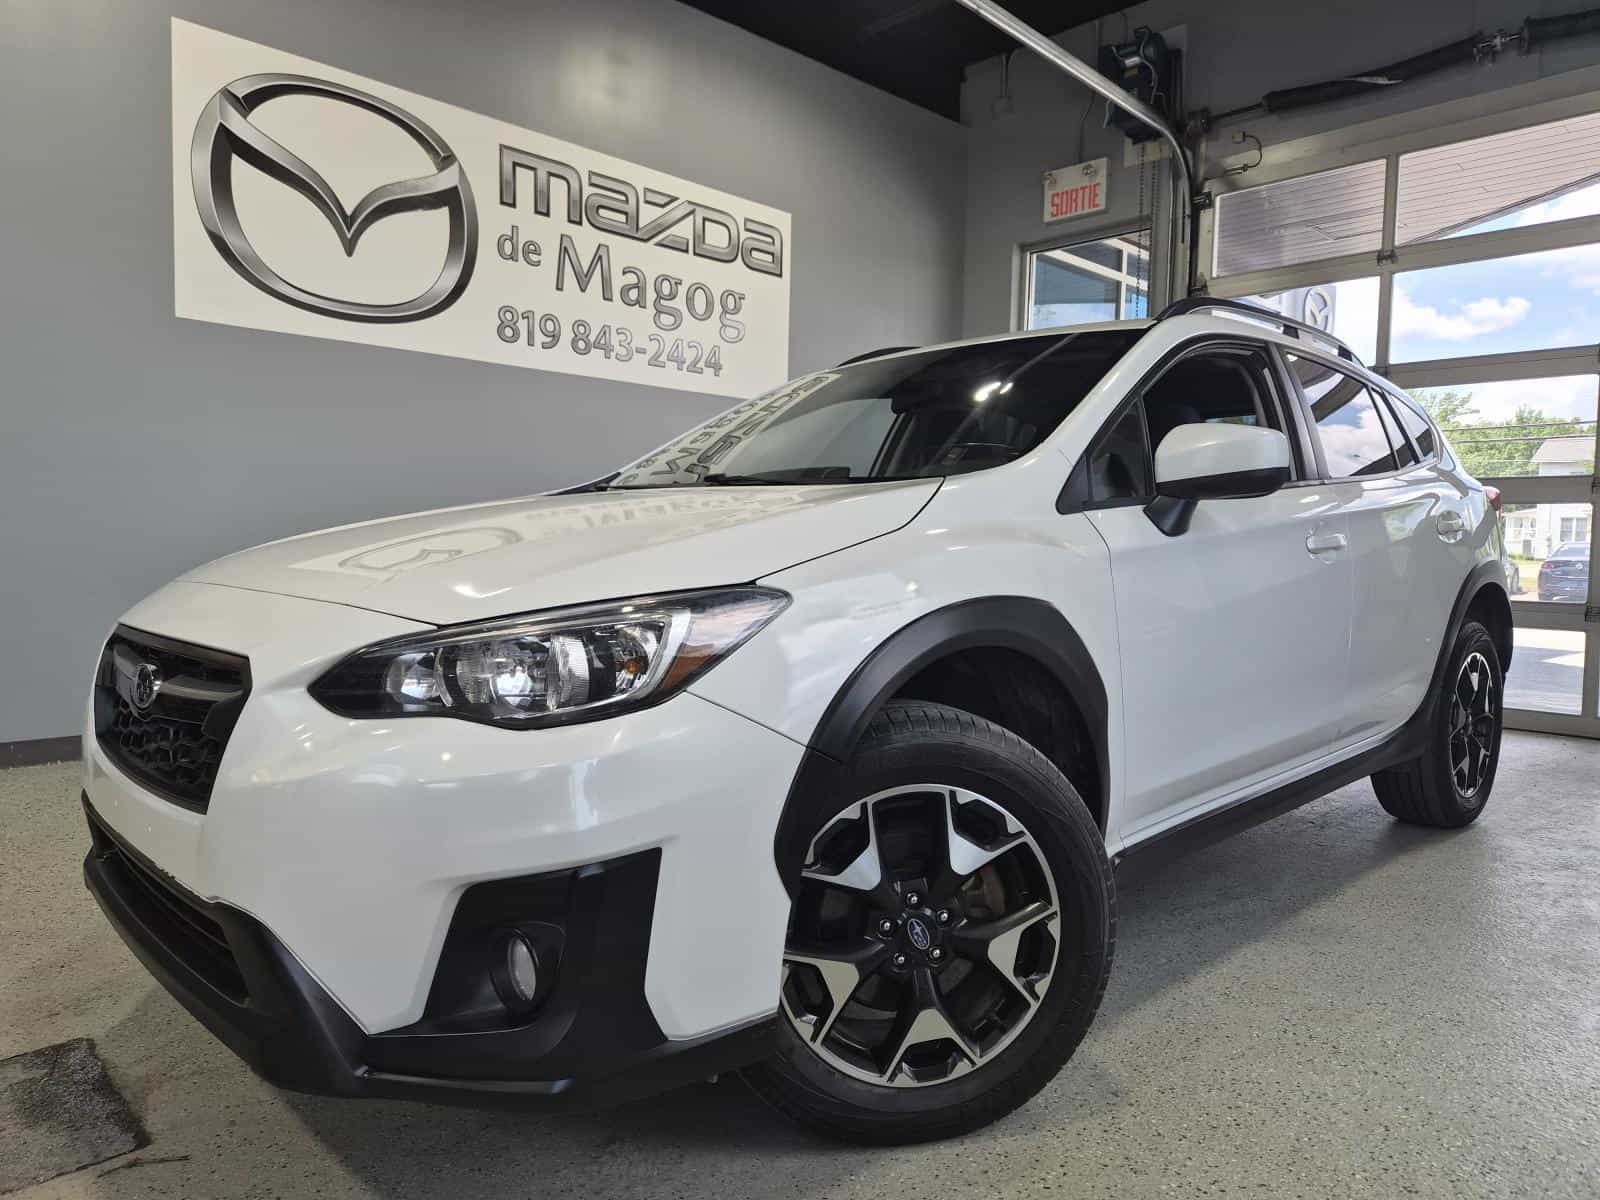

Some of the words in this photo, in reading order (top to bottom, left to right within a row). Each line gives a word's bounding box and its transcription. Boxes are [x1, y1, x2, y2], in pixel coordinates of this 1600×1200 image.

[1051, 183, 1101, 217] SORTIE
[497, 225, 542, 267] de
[555, 233, 746, 343] Magog
[497, 305, 561, 349] 819
[570, 319, 724, 376] 843-2424
